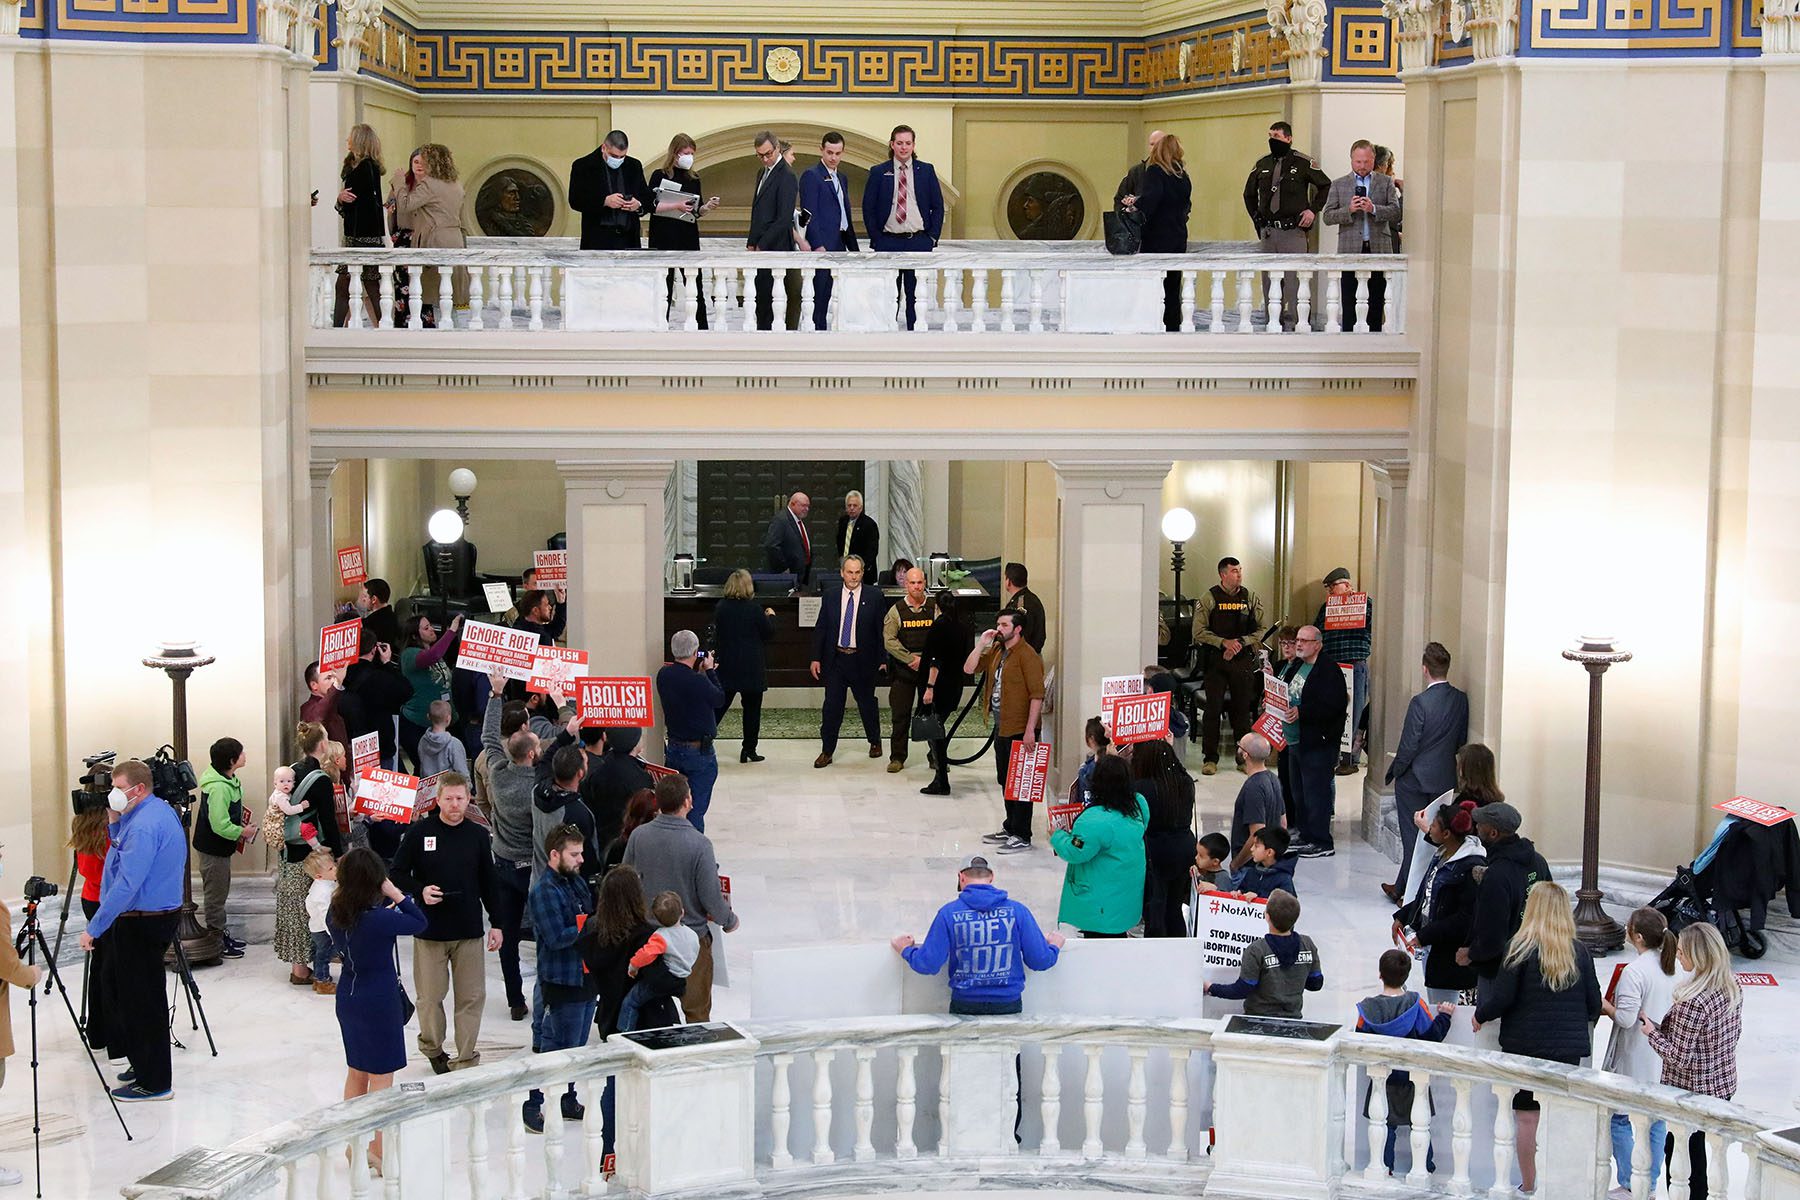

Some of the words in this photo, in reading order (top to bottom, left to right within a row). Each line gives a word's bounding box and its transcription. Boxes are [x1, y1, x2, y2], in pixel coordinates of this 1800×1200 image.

[536, 554, 561, 566] IGNORE
[1345, 594, 1365, 604] JUSTICE
[324, 627, 358, 654] ABOLISH
[466, 625, 506, 646] IGNORE
[508, 633, 535, 652] ROE!
[537, 648, 579, 661] ABOLISH
[582, 686, 646, 706] ABOLISH
[1104, 680, 1126, 694] IGNORE
[583, 707, 622, 718] ABORTION
[625, 708, 647, 719] NOW!
[1117, 700, 1166, 726] ABOLISH
[1116, 723, 1146, 737] ABORTION
[1148, 720, 1165, 733] NOW!
[1036, 745, 1049, 768] EQUAL
[370, 770, 410, 787] ABOLISH
[1021, 763, 1034, 799] PROTECTION
[1031, 769, 1046, 800] JUSTICE
[363, 800, 405, 816] ABORTION
[1721, 799, 1786, 818] ABOLISH
[953, 912, 973, 921] WE
[978, 908, 1014, 920] MUST
[954, 918, 1016, 947] OBEY
[1210, 929, 1230, 940] STOP
[956, 944, 1014, 973] GOD
